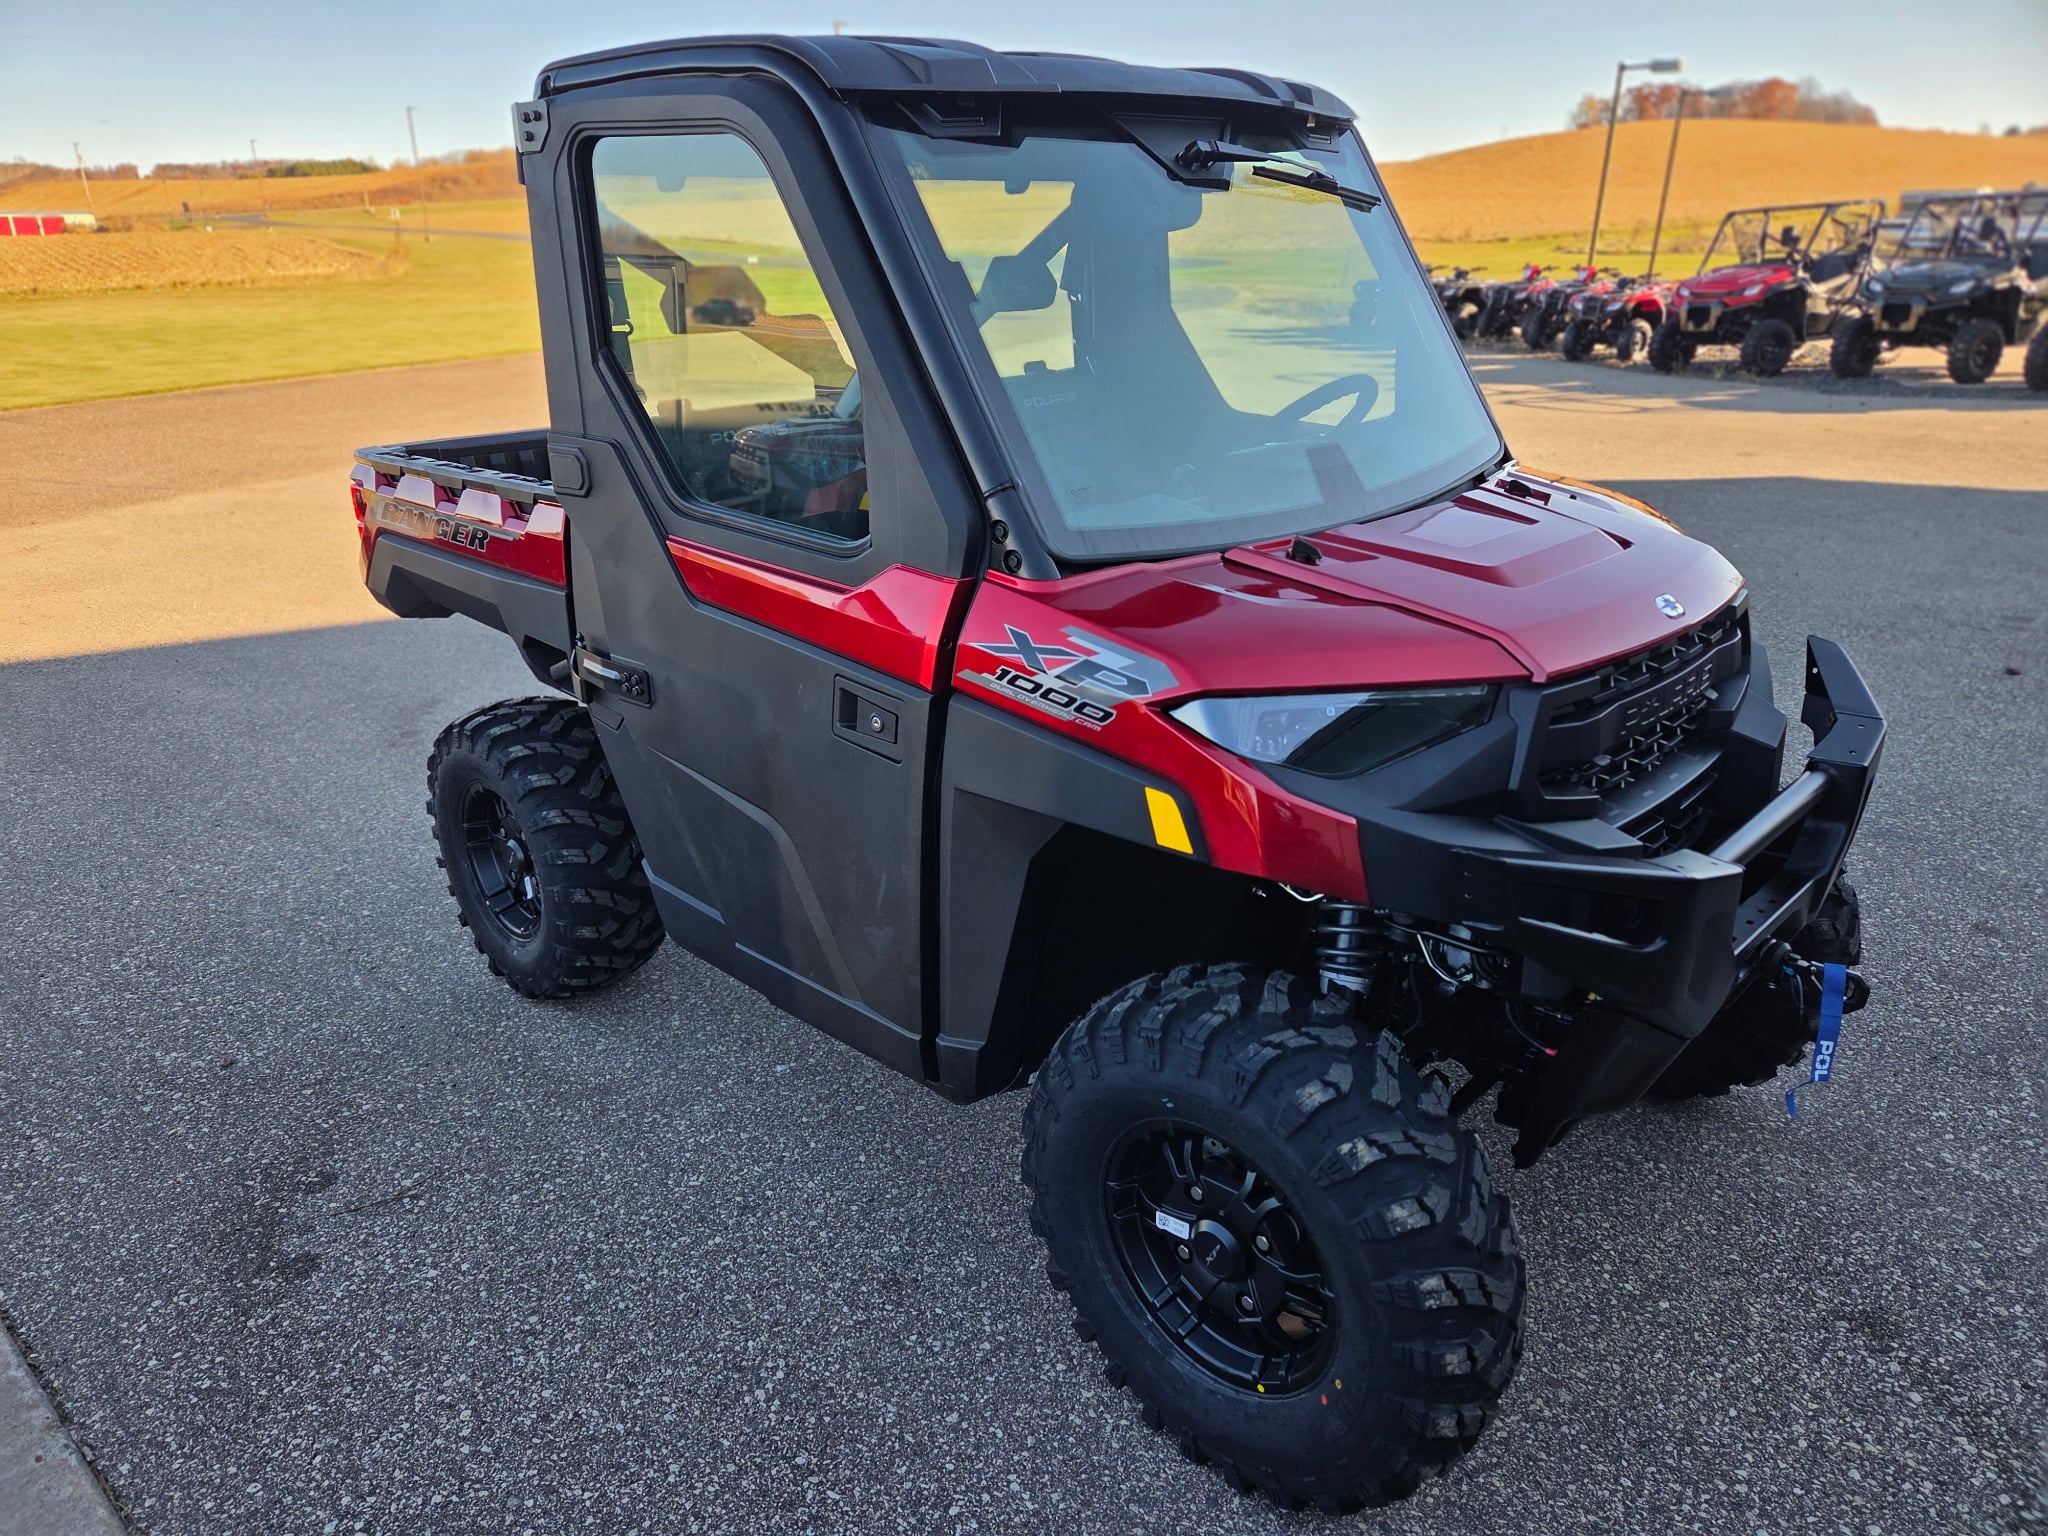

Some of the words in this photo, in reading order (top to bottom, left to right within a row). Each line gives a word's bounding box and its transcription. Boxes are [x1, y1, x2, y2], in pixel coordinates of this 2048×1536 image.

[377, 500, 490, 553] RANGER
[968, 623, 1152, 698] XP
[989, 682, 1015, 697] DUAL
[1017, 694, 1075, 720] OVERHEAD
[1074, 718, 1103, 732] CAM
[995, 665, 1117, 726] 1000
